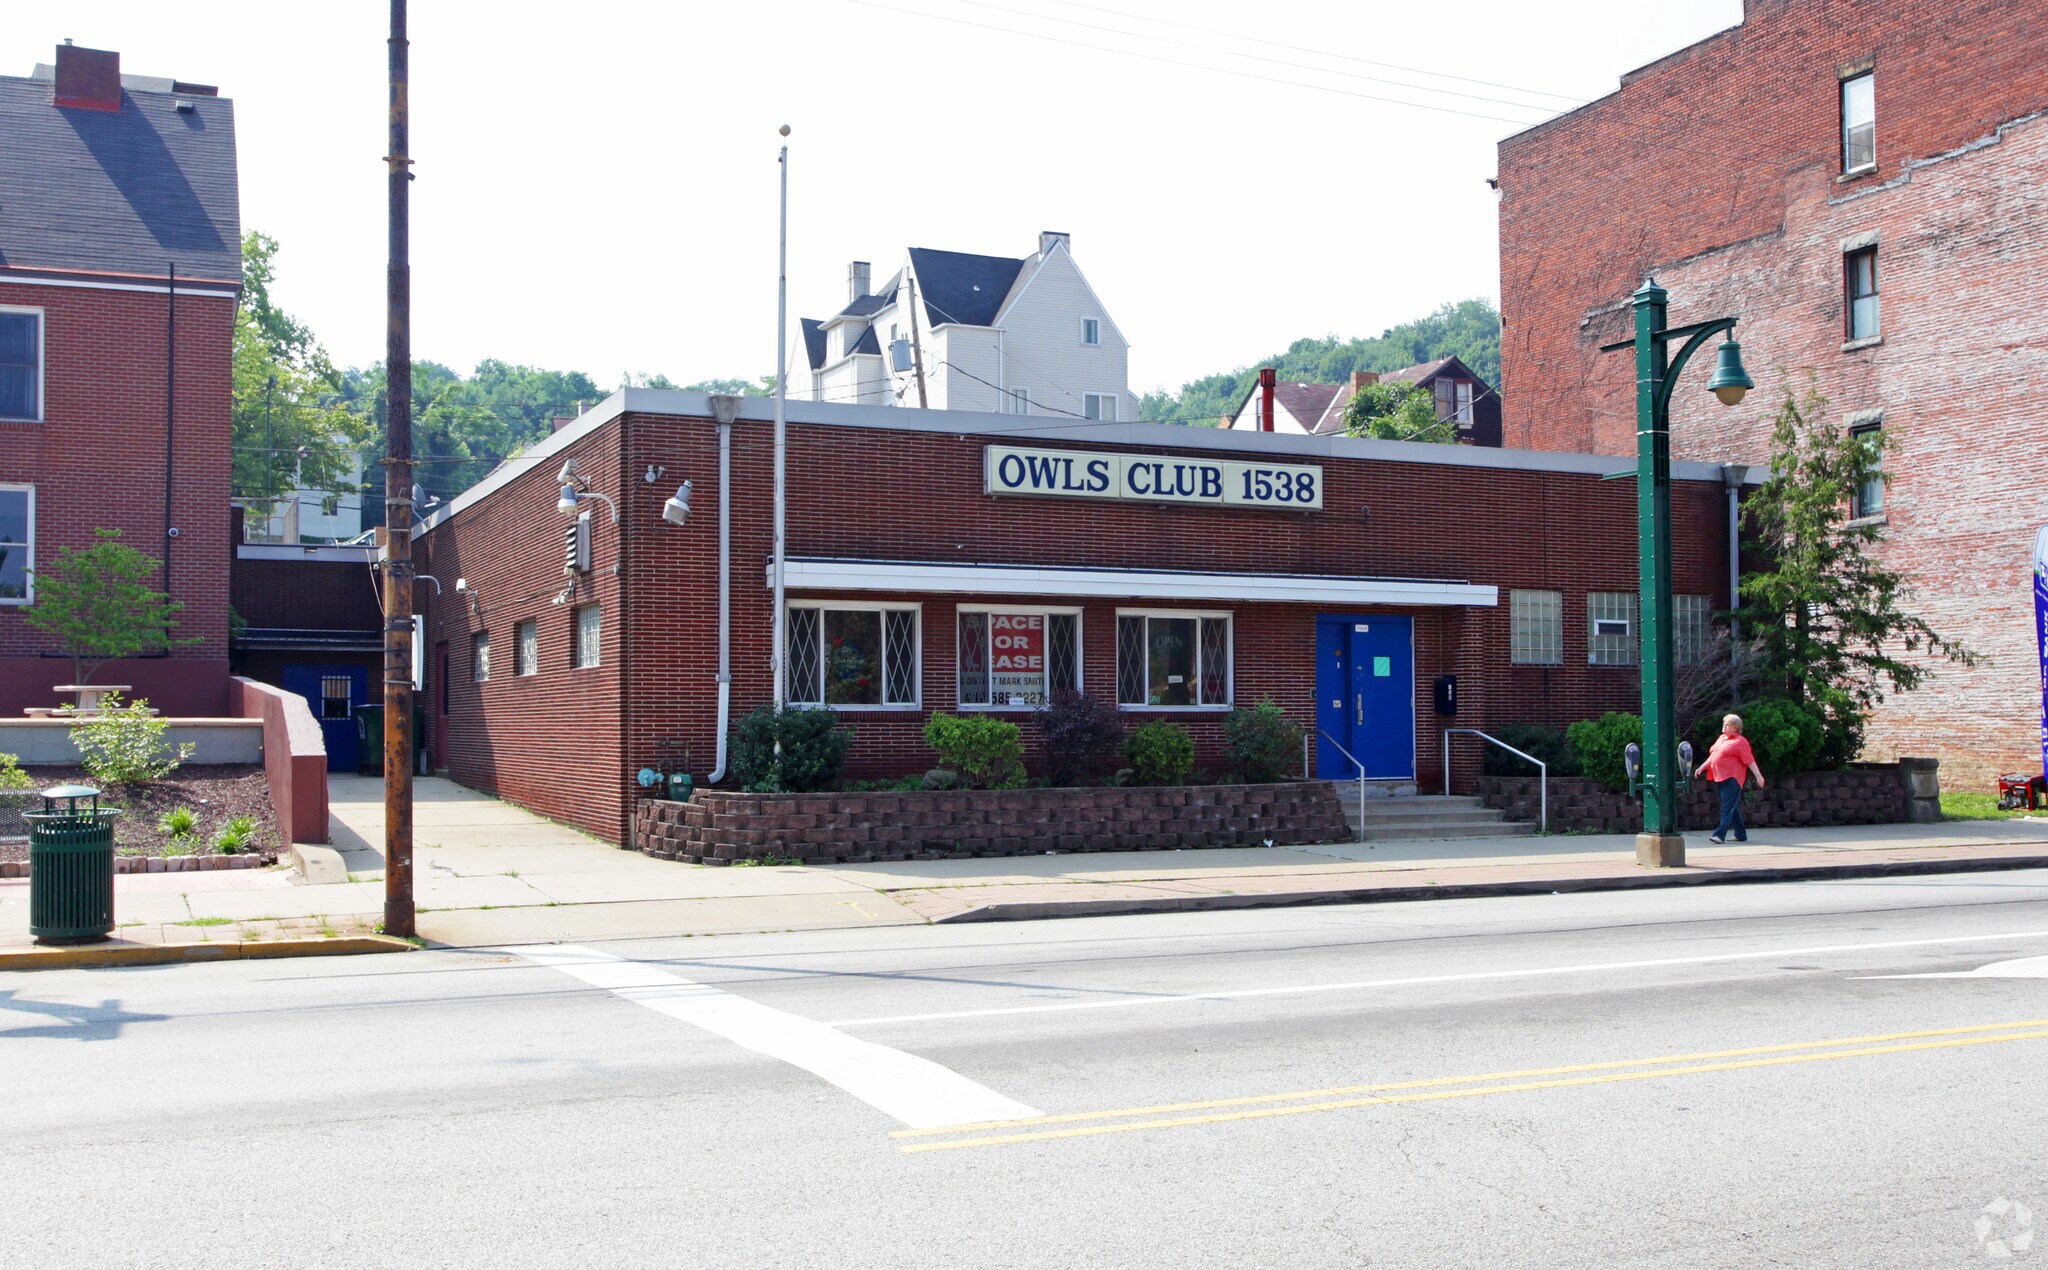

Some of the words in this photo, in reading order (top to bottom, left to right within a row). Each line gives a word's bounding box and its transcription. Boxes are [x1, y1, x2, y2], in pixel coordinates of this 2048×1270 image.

[998, 454, 1110, 492] OWLS
[1127, 462, 1222, 498] CLUB
[1242, 469, 1315, 503] 1538
[981, 635, 1030, 649] OR
[1156, 635, 1183, 649] OPEN
[999, 677, 1022, 686] MARK
